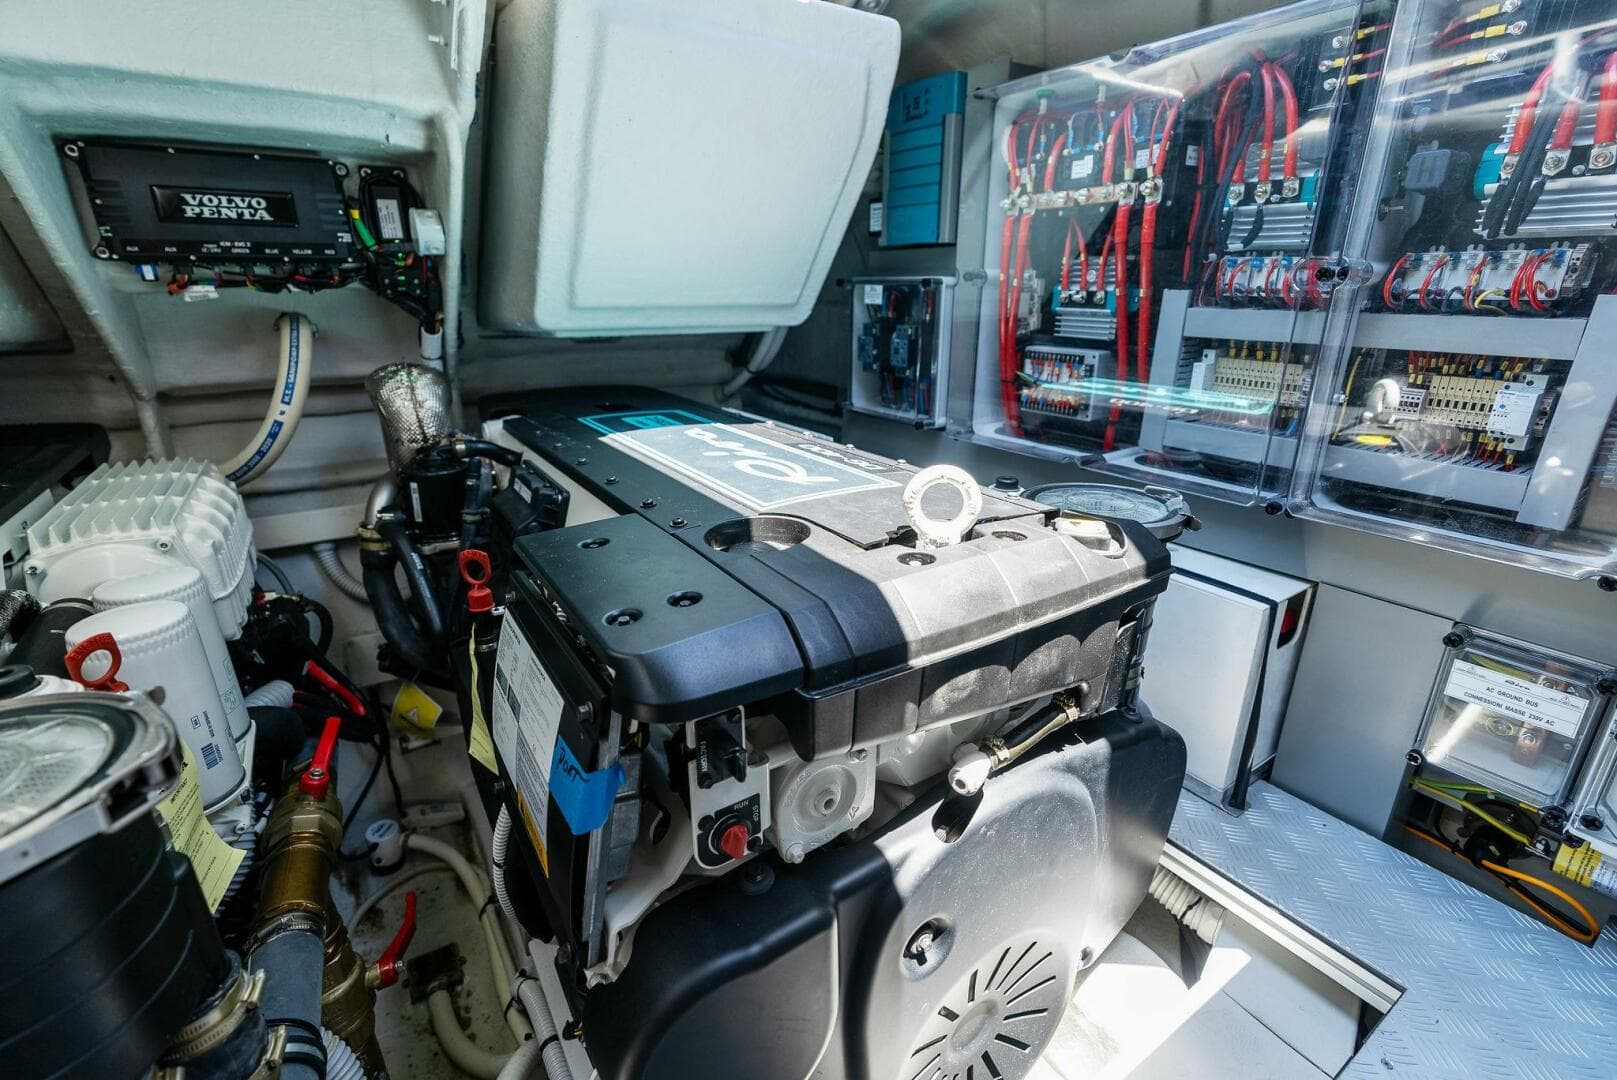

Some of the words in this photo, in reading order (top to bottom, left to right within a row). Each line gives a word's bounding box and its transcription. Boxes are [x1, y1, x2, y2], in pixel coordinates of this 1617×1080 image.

[180, 193, 267, 209] VOLVO
[181, 205, 274, 220] PENTA
[1497, 689, 1524, 703] GROUND
[1525, 699, 1539, 708] BUS
[1464, 691, 1503, 709] CONNESSIONI
[1505, 705, 1526, 717] MASSE
[1528, 712, 1544, 722] 230V
[1545, 719, 1555, 727] AC
[734, 799, 749, 811] RUN
[752, 805, 760, 822] STOP
